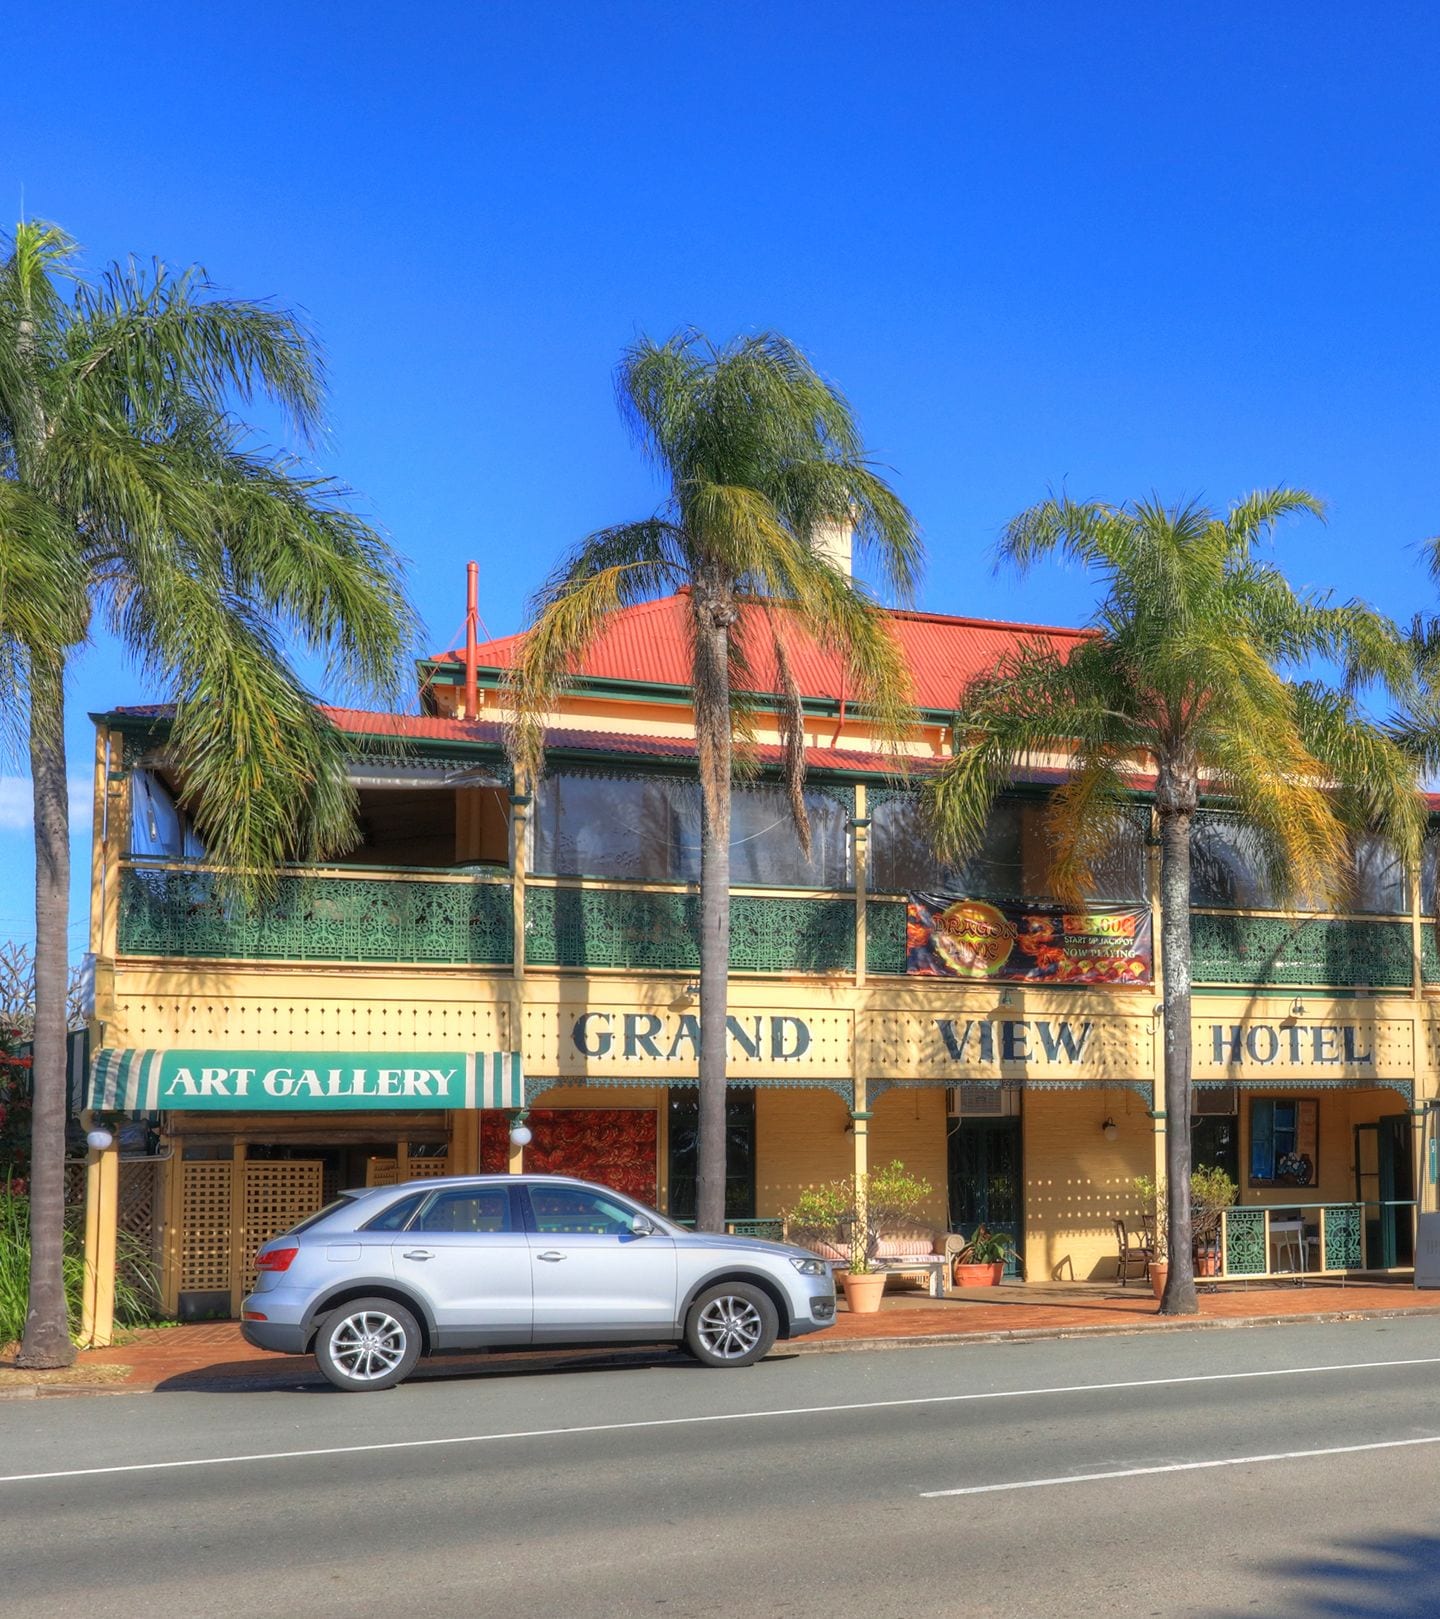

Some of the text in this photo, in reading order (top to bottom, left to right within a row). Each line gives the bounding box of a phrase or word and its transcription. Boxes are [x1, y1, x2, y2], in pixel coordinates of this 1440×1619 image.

[932, 914, 1018, 939] DRAGON
[1063, 948, 1136, 958] NOW PLAYING
[1064, 936, 1086, 944] START
[1099, 937, 1135, 946] JACKPOT
[573, 1012, 1371, 1063] GRAND VIEW HOTEL
[165, 1068, 458, 1097] ART GALLERY
